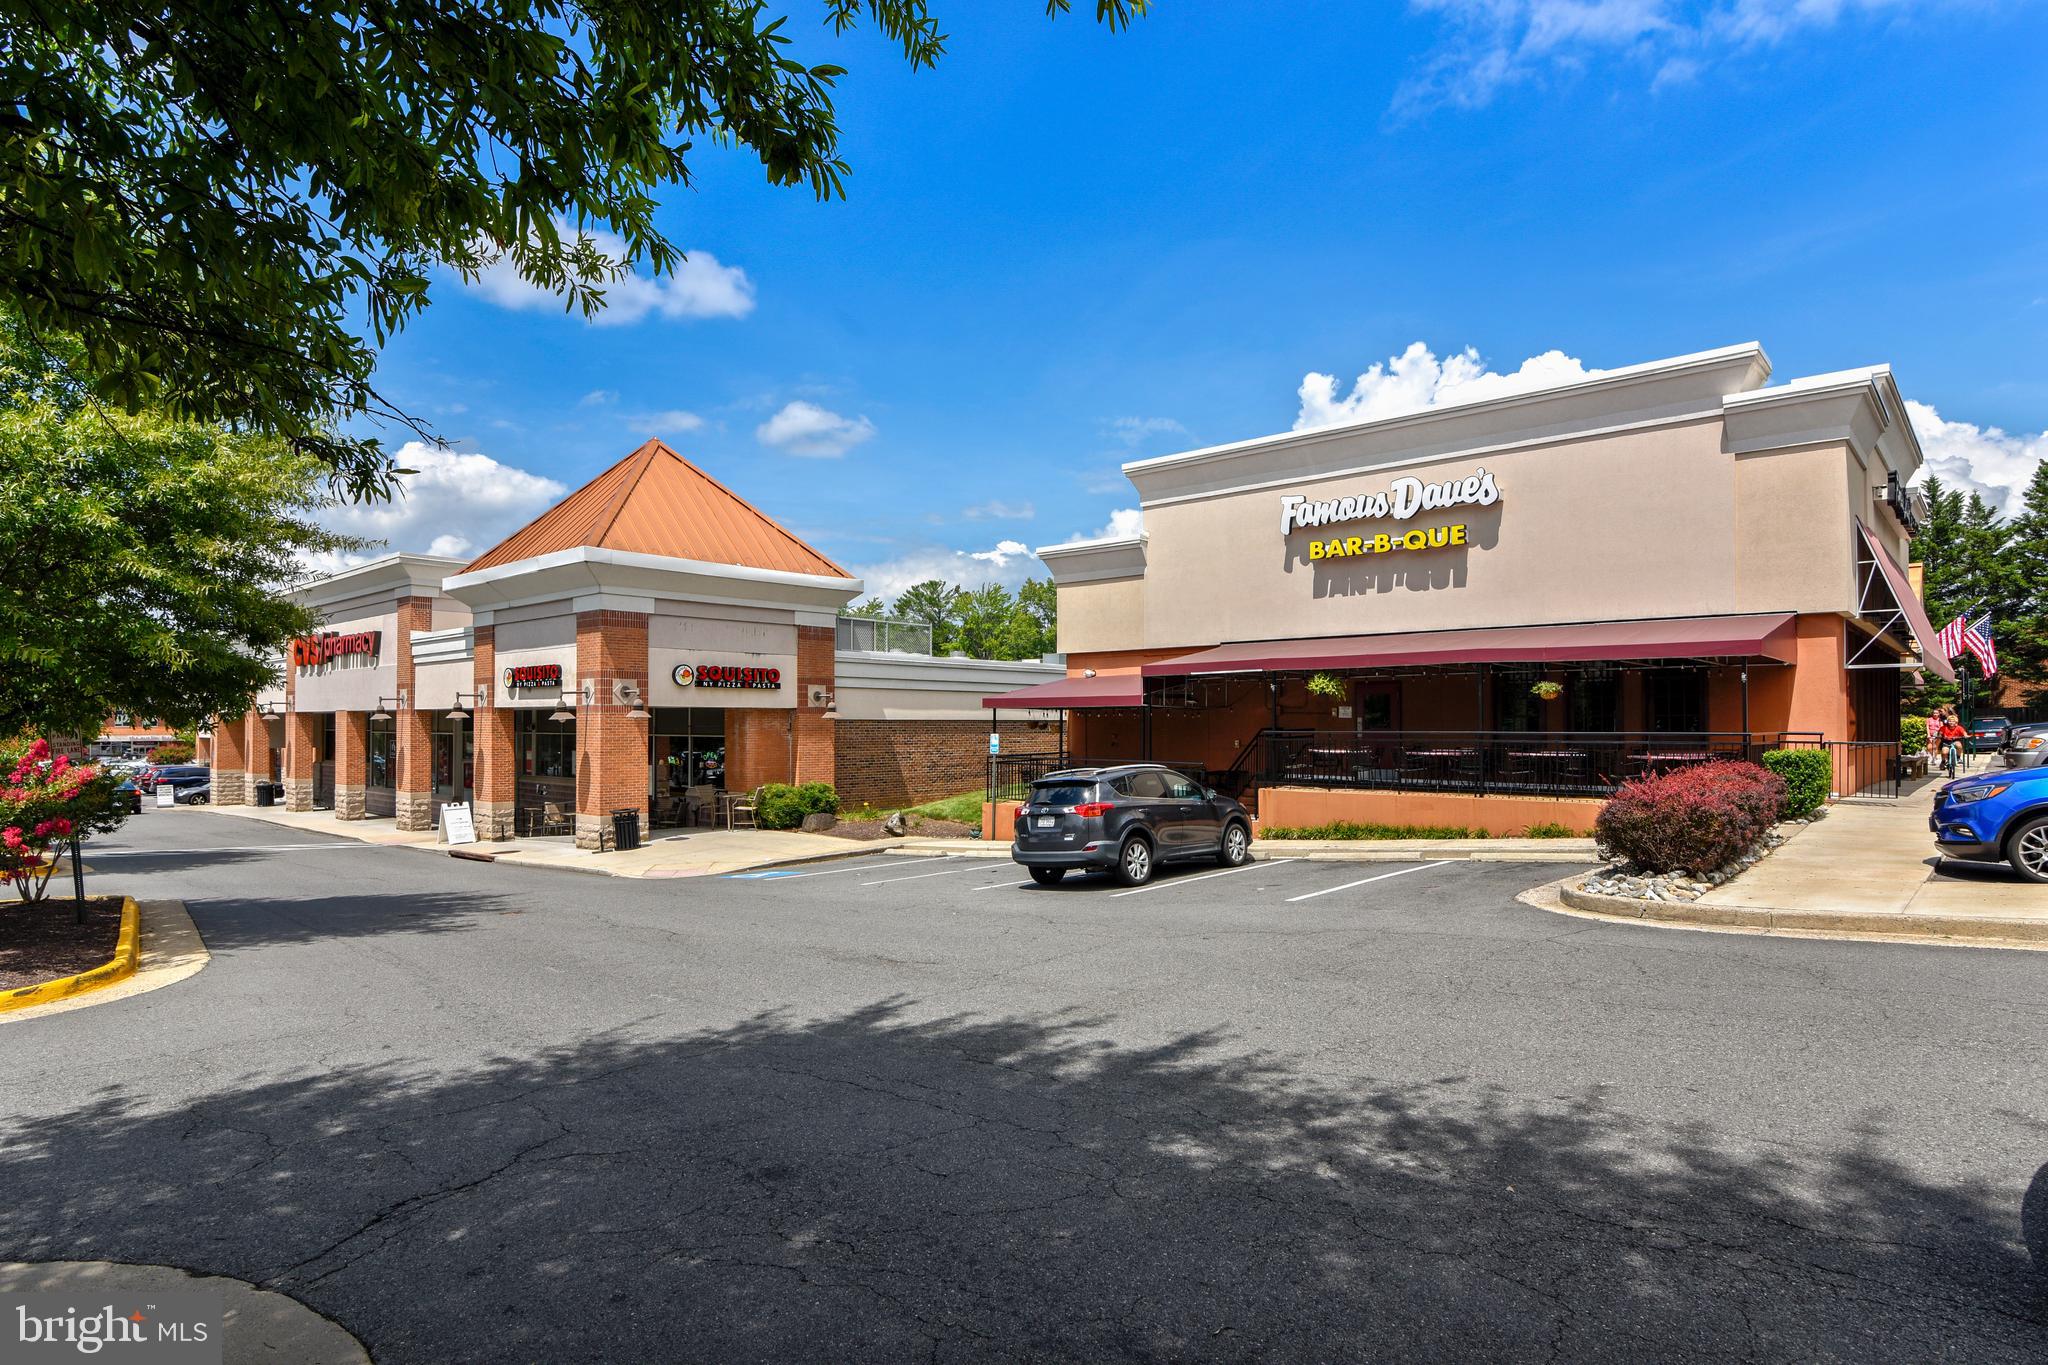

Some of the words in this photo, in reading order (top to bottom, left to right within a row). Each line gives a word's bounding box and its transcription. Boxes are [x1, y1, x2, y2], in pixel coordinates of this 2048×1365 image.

[1280, 492, 1390, 535] Famous
[1390, 467, 1500, 520] Dave's
[1309, 524, 1467, 560] BAR-B-QUE
[514, 664, 559, 681] SQUISITO
[696, 665, 780, 683] SQUISITO
